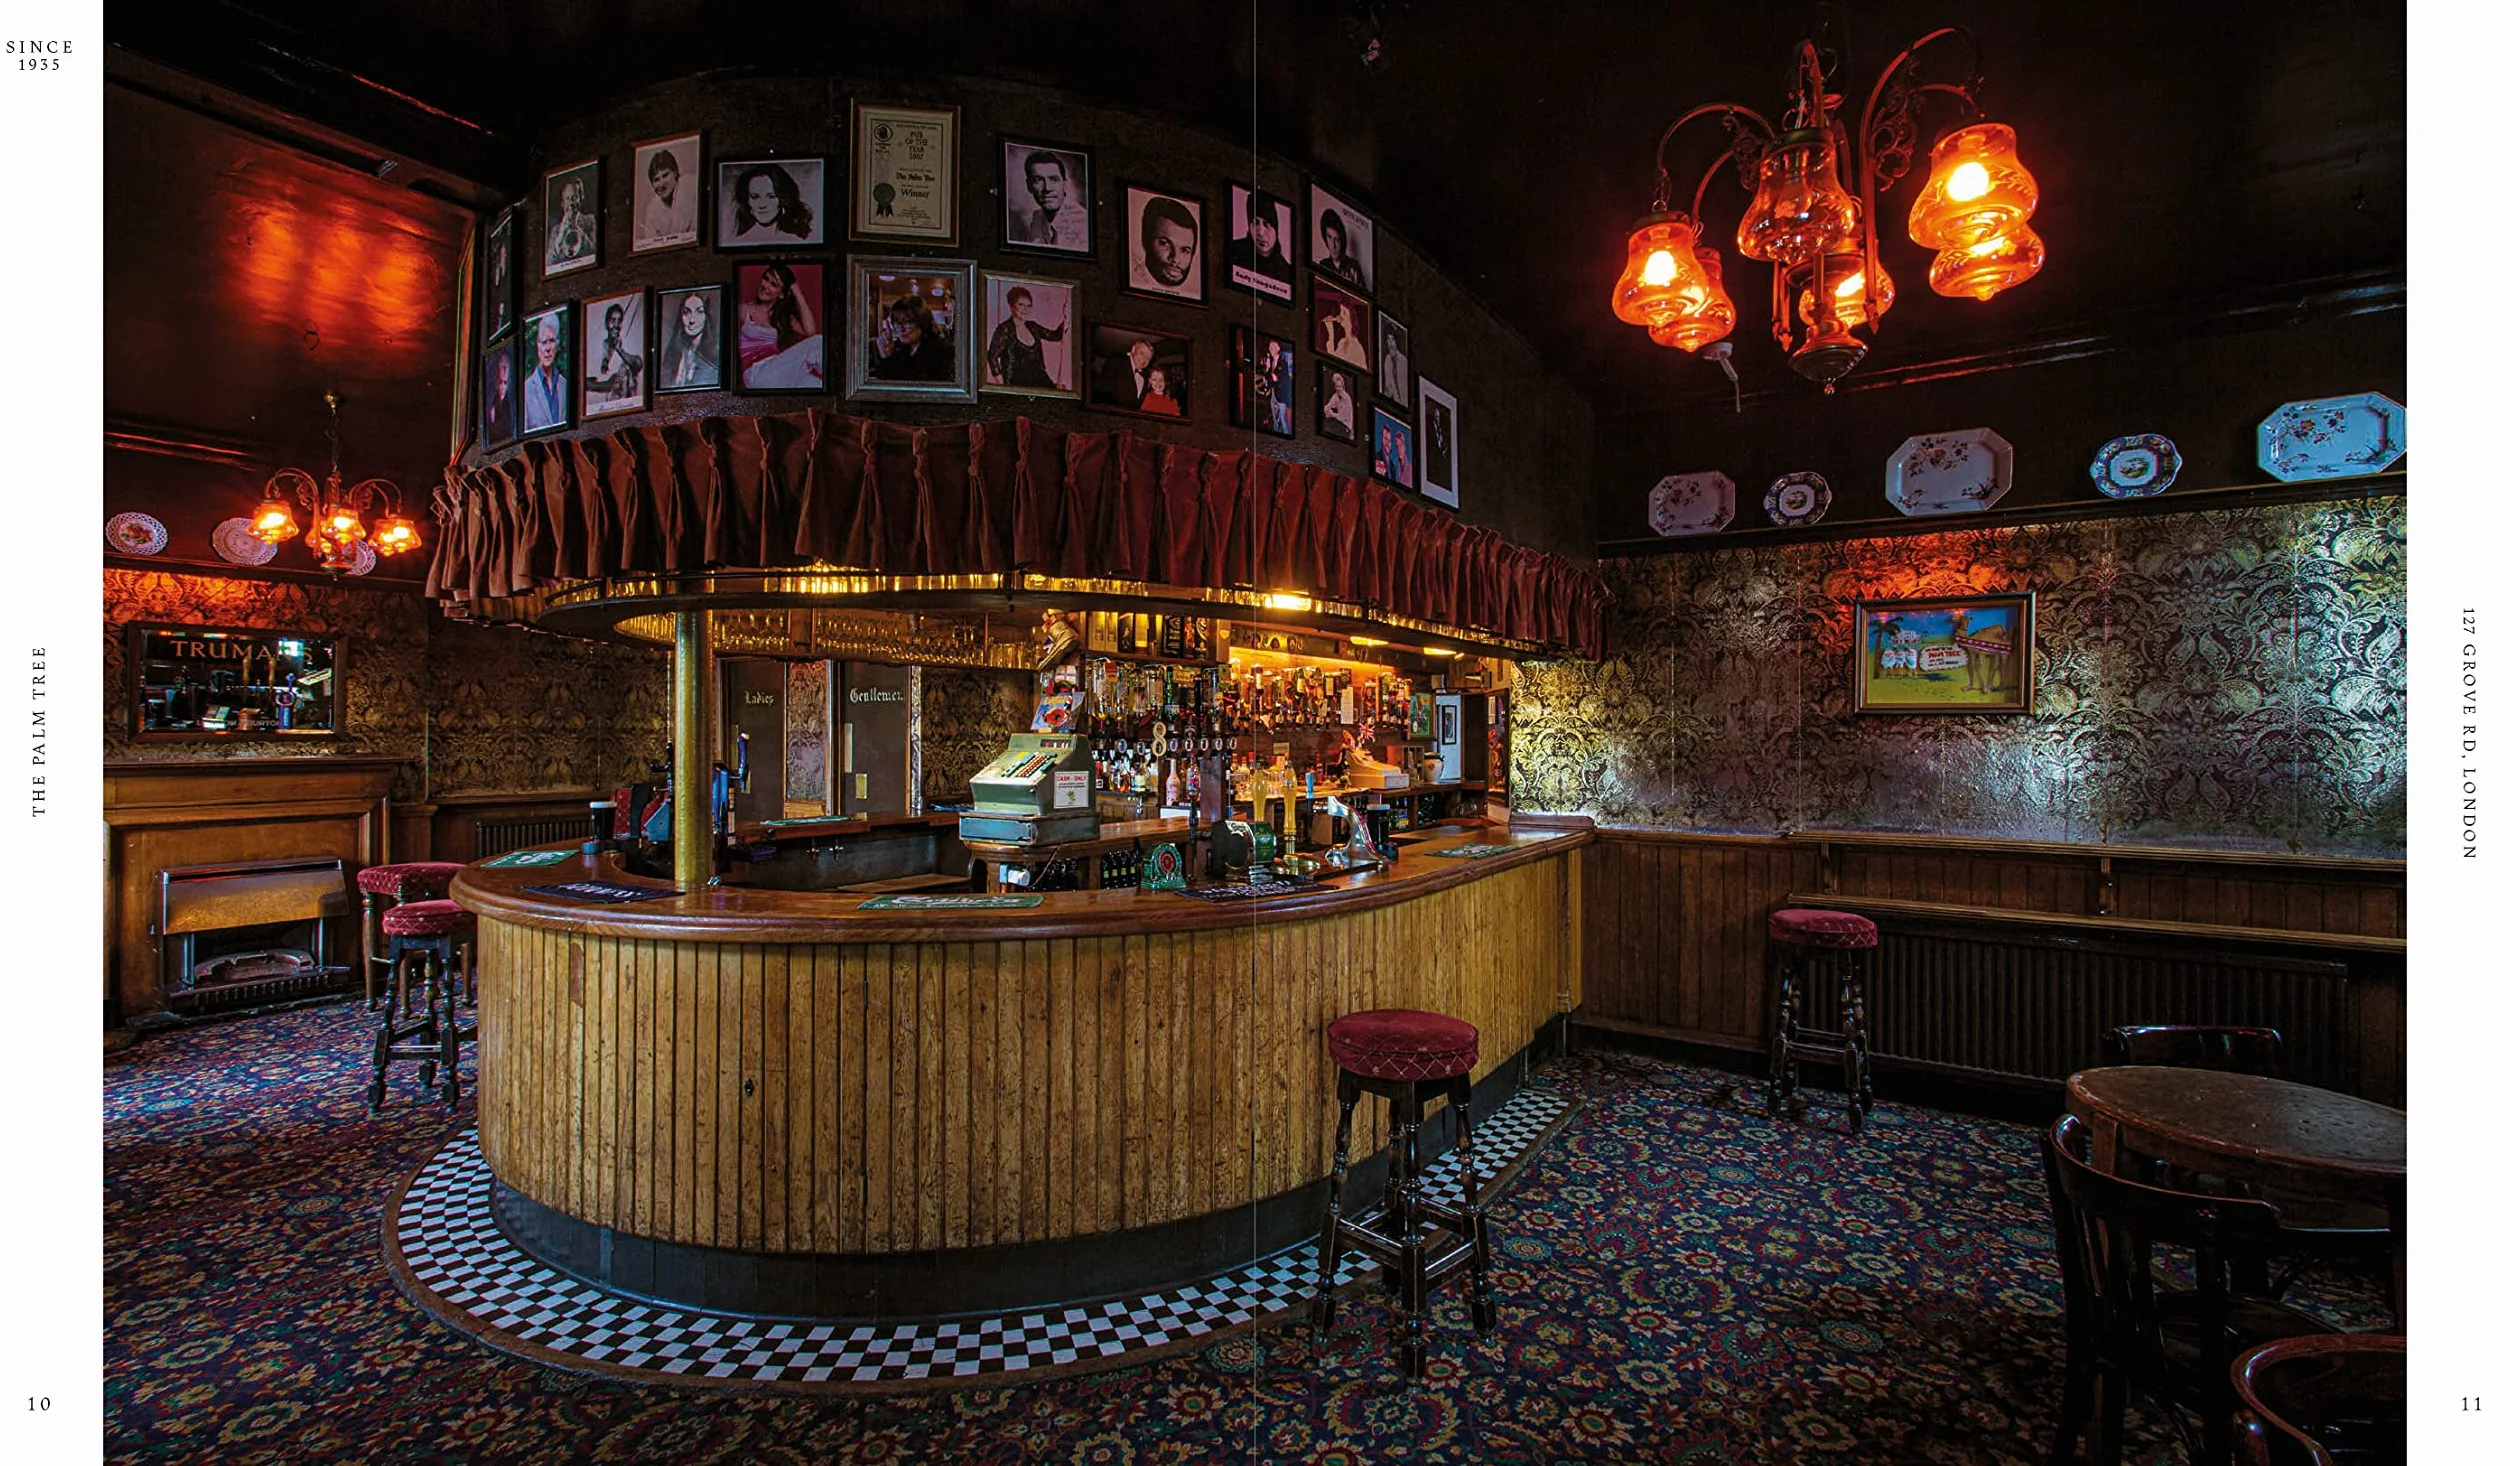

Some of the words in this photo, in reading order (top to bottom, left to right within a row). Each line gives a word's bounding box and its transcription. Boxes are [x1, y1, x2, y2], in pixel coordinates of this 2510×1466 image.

[901, 188, 930, 198] Winner
[744, 690, 775, 706] Ladies
[849, 687, 904, 704] Gentlemen
